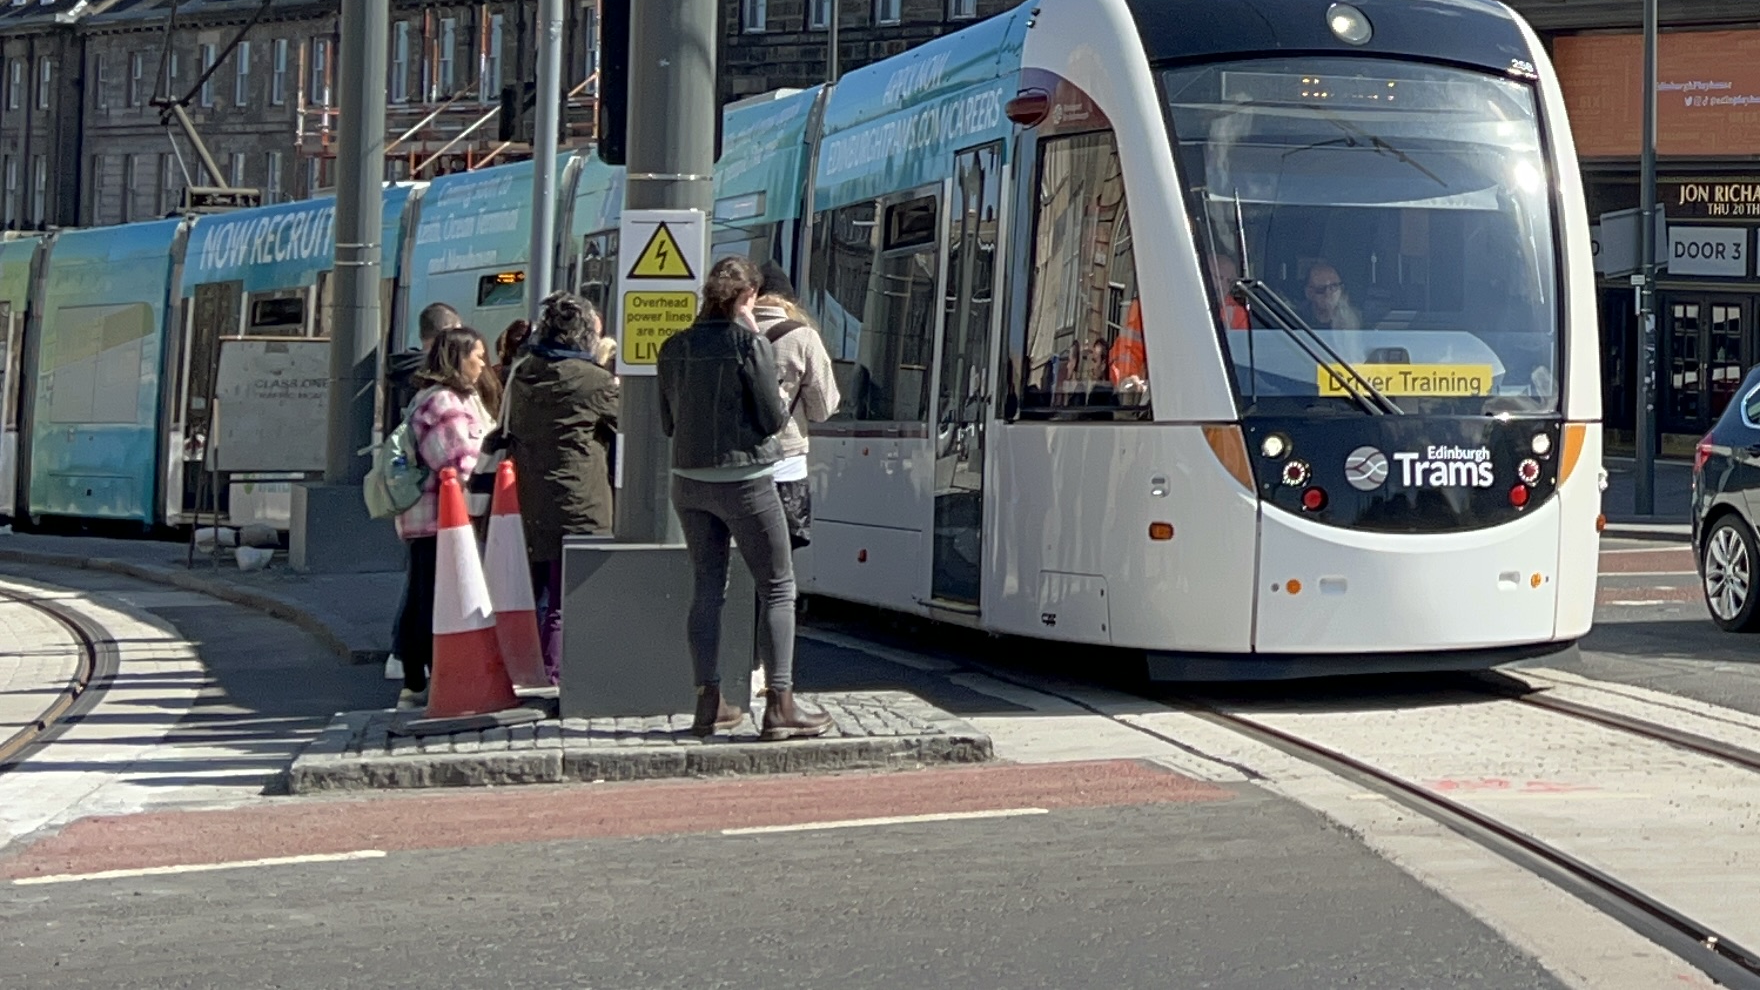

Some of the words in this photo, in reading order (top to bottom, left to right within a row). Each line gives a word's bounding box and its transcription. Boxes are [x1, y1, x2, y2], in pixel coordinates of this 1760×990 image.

[1678, 184, 1709, 205] JON
[1707, 203, 1729, 216] THU
[200, 219, 257, 270] NOW
[250, 206, 337, 265] RECRUIT
[1674, 241, 1726, 260] DOOR
[1732, 243, 1741, 260] 3
[632, 296, 688, 309] Overhead
[627, 312, 662, 324] power
[665, 311, 692, 323] lines
[636, 327, 655, 337] are
[658, 326, 682, 337] no
[1329, 371, 1393, 392] Drier
[1399, 371, 1481, 395] Training
[1427, 445, 1490, 463] Edinburgh
[1393, 452, 1494, 488] Trams
